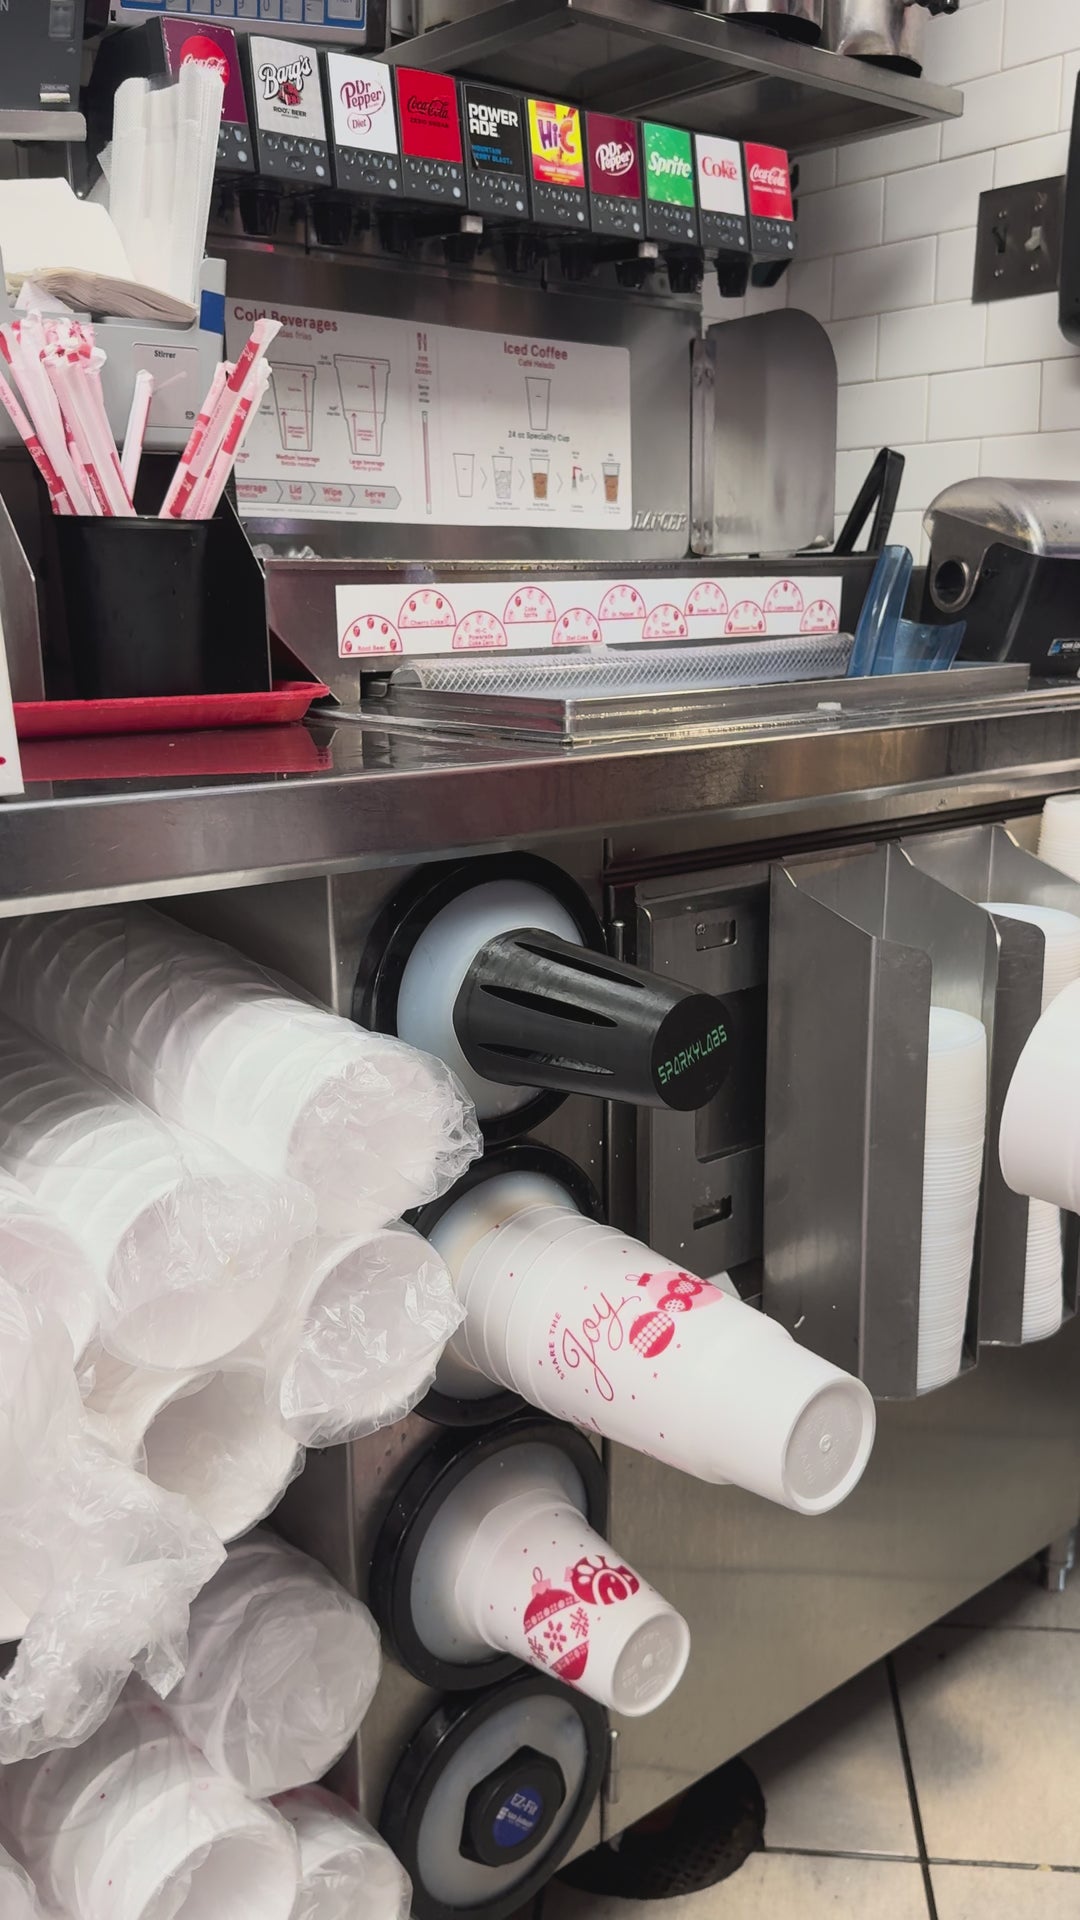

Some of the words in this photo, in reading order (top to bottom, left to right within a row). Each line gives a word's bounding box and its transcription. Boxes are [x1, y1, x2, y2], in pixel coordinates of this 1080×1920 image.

[258, 55, 313, 100] Barq's
[355, 80, 371, 93] Dr
[344, 82, 382, 110] Pepper
[407, 95, 449, 119] Coca-Cola
[351, 119, 366, 129] Diet
[468, 103, 518, 127] POWER
[469, 119, 499, 138] ADE
[599, 144, 631, 172] Pepper
[608, 141, 622, 154] Dr
[648, 151, 692, 177] Sprite
[702, 156, 738, 182] Coke
[749, 163, 787, 188] Coca-Cola
[234, 306, 266, 322] Cold
[271, 310, 338, 334] Beverages
[154, 350, 176, 359] Stirrer
[503, 341, 528, 356] Iced
[530, 344, 568, 361] Coffee
[289, 485, 302, 495] Lid
[323, 486, 343, 498] Wipe
[364, 489, 386, 499] Serve
[657, 1024, 728, 1085] SPARKYLABS
[549, 1312, 562, 1335] THE
[562, 1292, 642, 1401] Joy
[548, 1341, 566, 1380] SHARE
